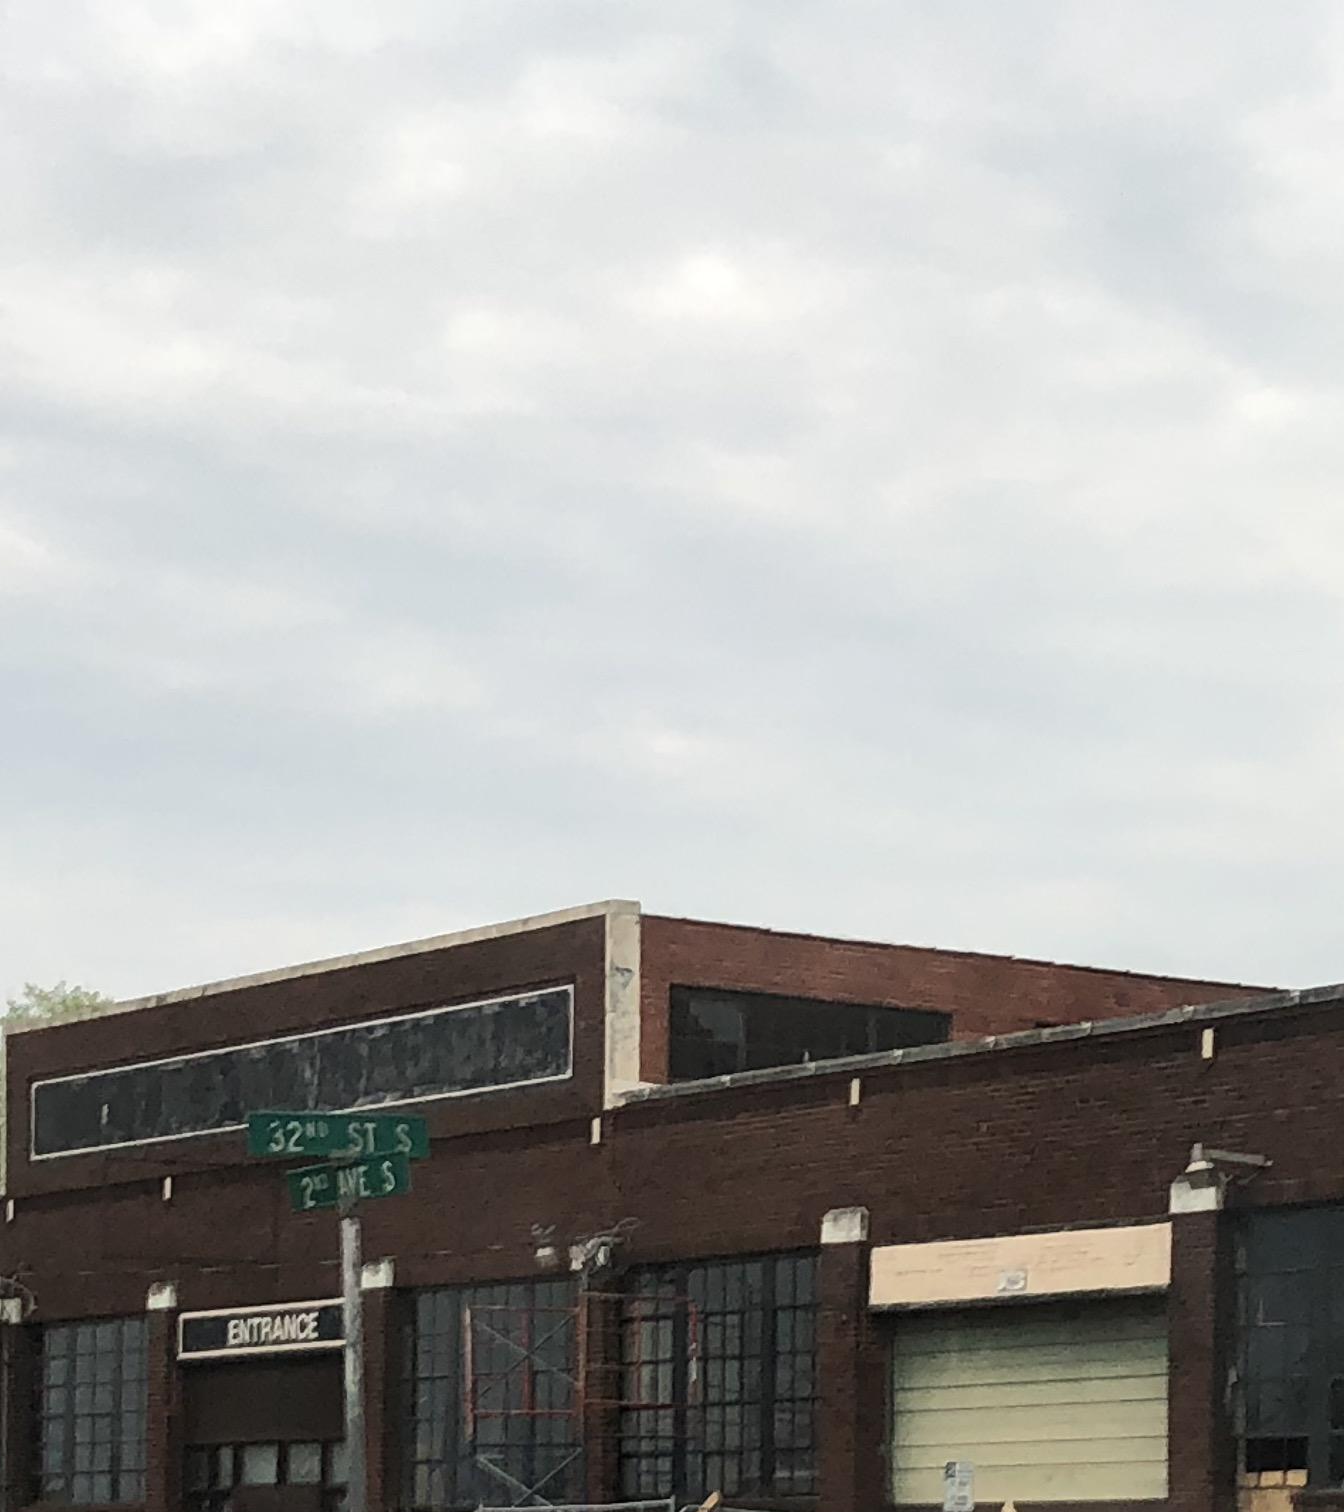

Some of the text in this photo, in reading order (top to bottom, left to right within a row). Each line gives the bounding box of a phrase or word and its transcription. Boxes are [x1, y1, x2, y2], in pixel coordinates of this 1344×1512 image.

[347, 1121, 376, 1153] ST
[395, 1123, 413, 1152] S
[336, 1164, 371, 1198] AVE
[381, 1160, 396, 1193] S
[226, 1311, 320, 1346] ENTRANCE
